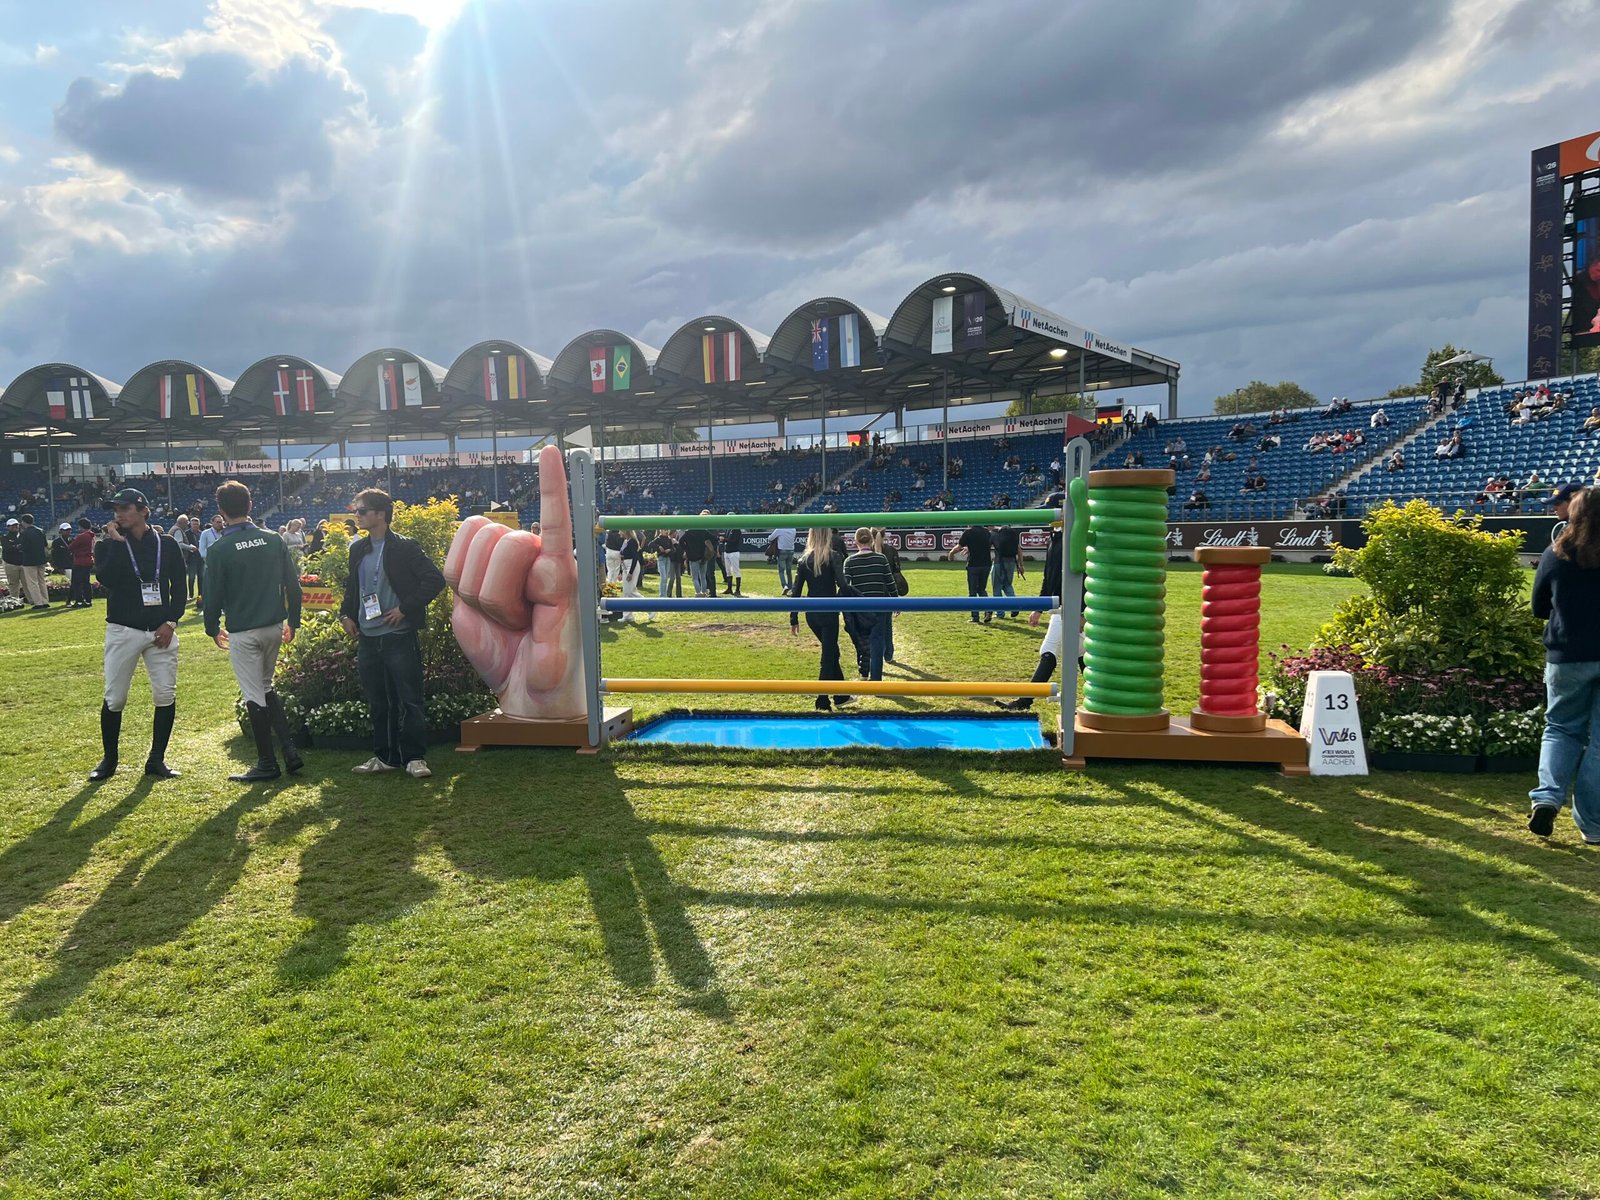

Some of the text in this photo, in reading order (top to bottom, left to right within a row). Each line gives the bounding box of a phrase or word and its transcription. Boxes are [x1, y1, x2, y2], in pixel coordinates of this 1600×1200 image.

[1032, 317, 1069, 338] NetAachen
[1095, 339, 1127, 357] NetAachen
[1019, 417, 1063, 428] NetAachen
[948, 424, 991, 434] NetAachen
[739, 441, 776, 449] NetAachen
[907, 537, 933, 546] LAMBERTZ
[1198, 528, 1248, 547] Lindt
[1274, 527, 1322, 547] Lindt
[235, 538, 267, 550] BRASIL
[1324, 693, 1349, 710] 13
[1322, 758, 1355, 766] AACHEN
